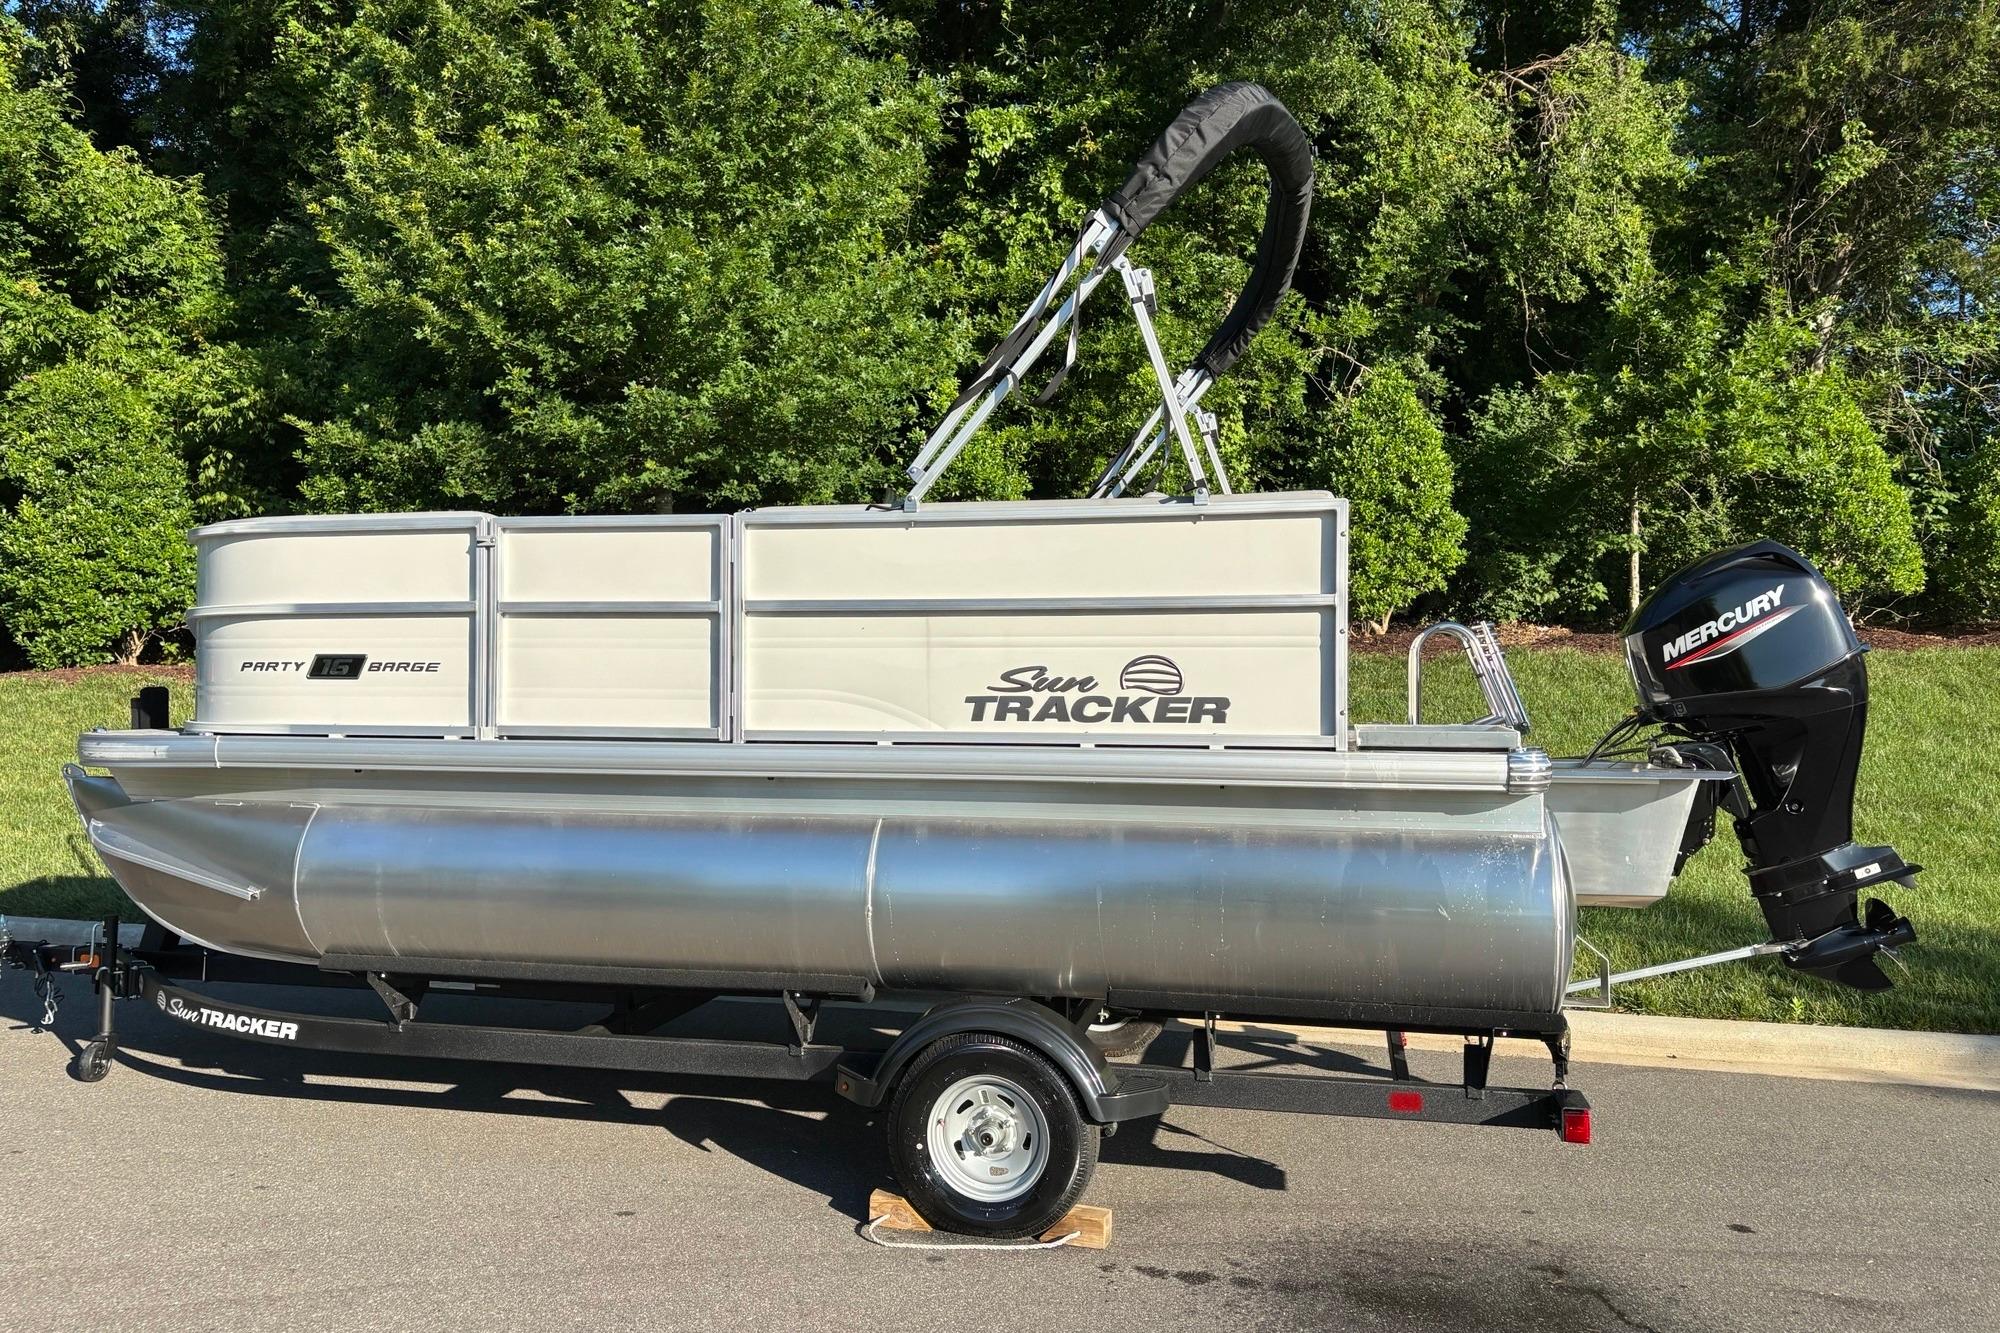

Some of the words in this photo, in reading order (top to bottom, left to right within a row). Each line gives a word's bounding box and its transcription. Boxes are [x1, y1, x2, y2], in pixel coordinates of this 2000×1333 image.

[1662, 584, 1785, 662] MERCURY
[240, 661, 306, 672] PARTY
[367, 661, 441, 672] BARGE
[986, 665, 1099, 693] Sun
[964, 695, 1231, 724] TRACKER
[166, 998, 200, 1022] Sun
[199, 1007, 299, 1040] TRACKER
